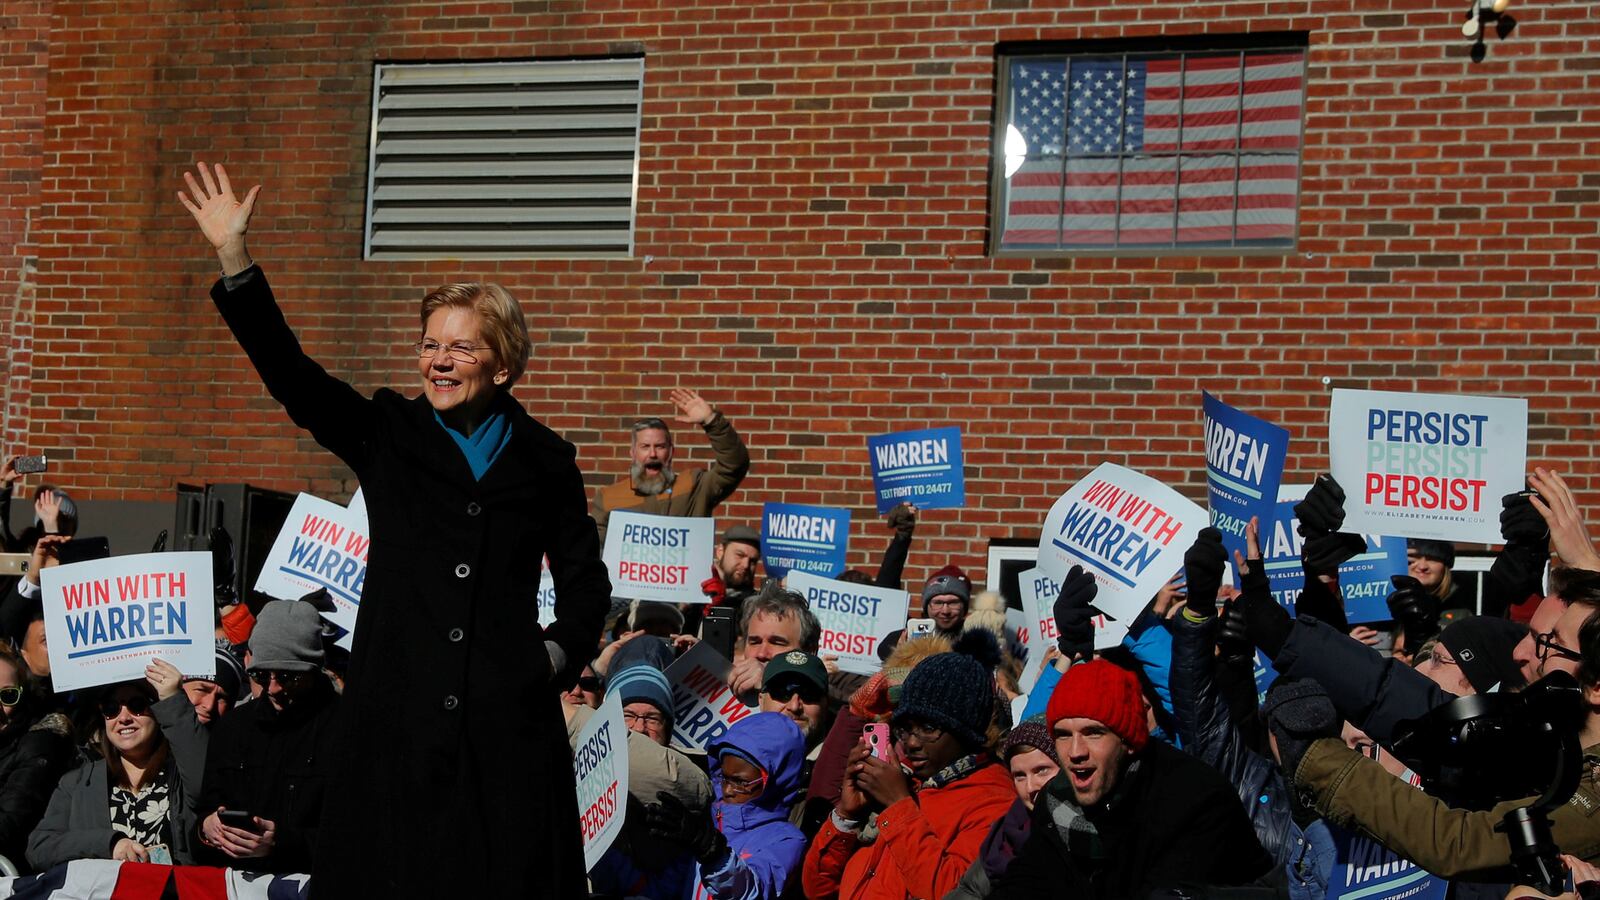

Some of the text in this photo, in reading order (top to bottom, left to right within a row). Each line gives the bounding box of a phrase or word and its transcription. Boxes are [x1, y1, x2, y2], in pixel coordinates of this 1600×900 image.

[1368, 408, 1488, 447] PERSIST
[875, 438, 948, 470] WARREN
[1367, 441, 1488, 480] PERSIST
[893, 485, 912, 498] FIGHT
[913, 485, 925, 495] TO
[926, 482, 952, 494] 24477
[1365, 473, 1487, 512] PERSIST
[769, 512, 836, 543] WARREN
[1081, 479, 1183, 546] WIN WITH
[1218, 512, 1248, 539] 2447
[1364, 510, 1486, 523] WWW.ELIZABETHWARREN.COM
[301, 513, 345, 546] WIN
[622, 523, 690, 547] PERSIST
[1060, 502, 1162, 577] WARREN
[288, 535, 366, 596] WARRE
[620, 542, 690, 566] PERSIST
[796, 559, 806, 569] TO
[807, 560, 834, 572] 24477
[619, 560, 689, 585] PERSIST
[62, 572, 186, 611] WIN WITH
[808, 587, 882, 617] PERSIST
[1346, 581, 1389, 599] 24477
[65, 601, 187, 648] WARREN
[820, 628, 878, 656] RSIST
[682, 664, 729, 704] WIN
[575, 720, 612, 781] PERSIST
[580, 780, 618, 846] PERSIST
